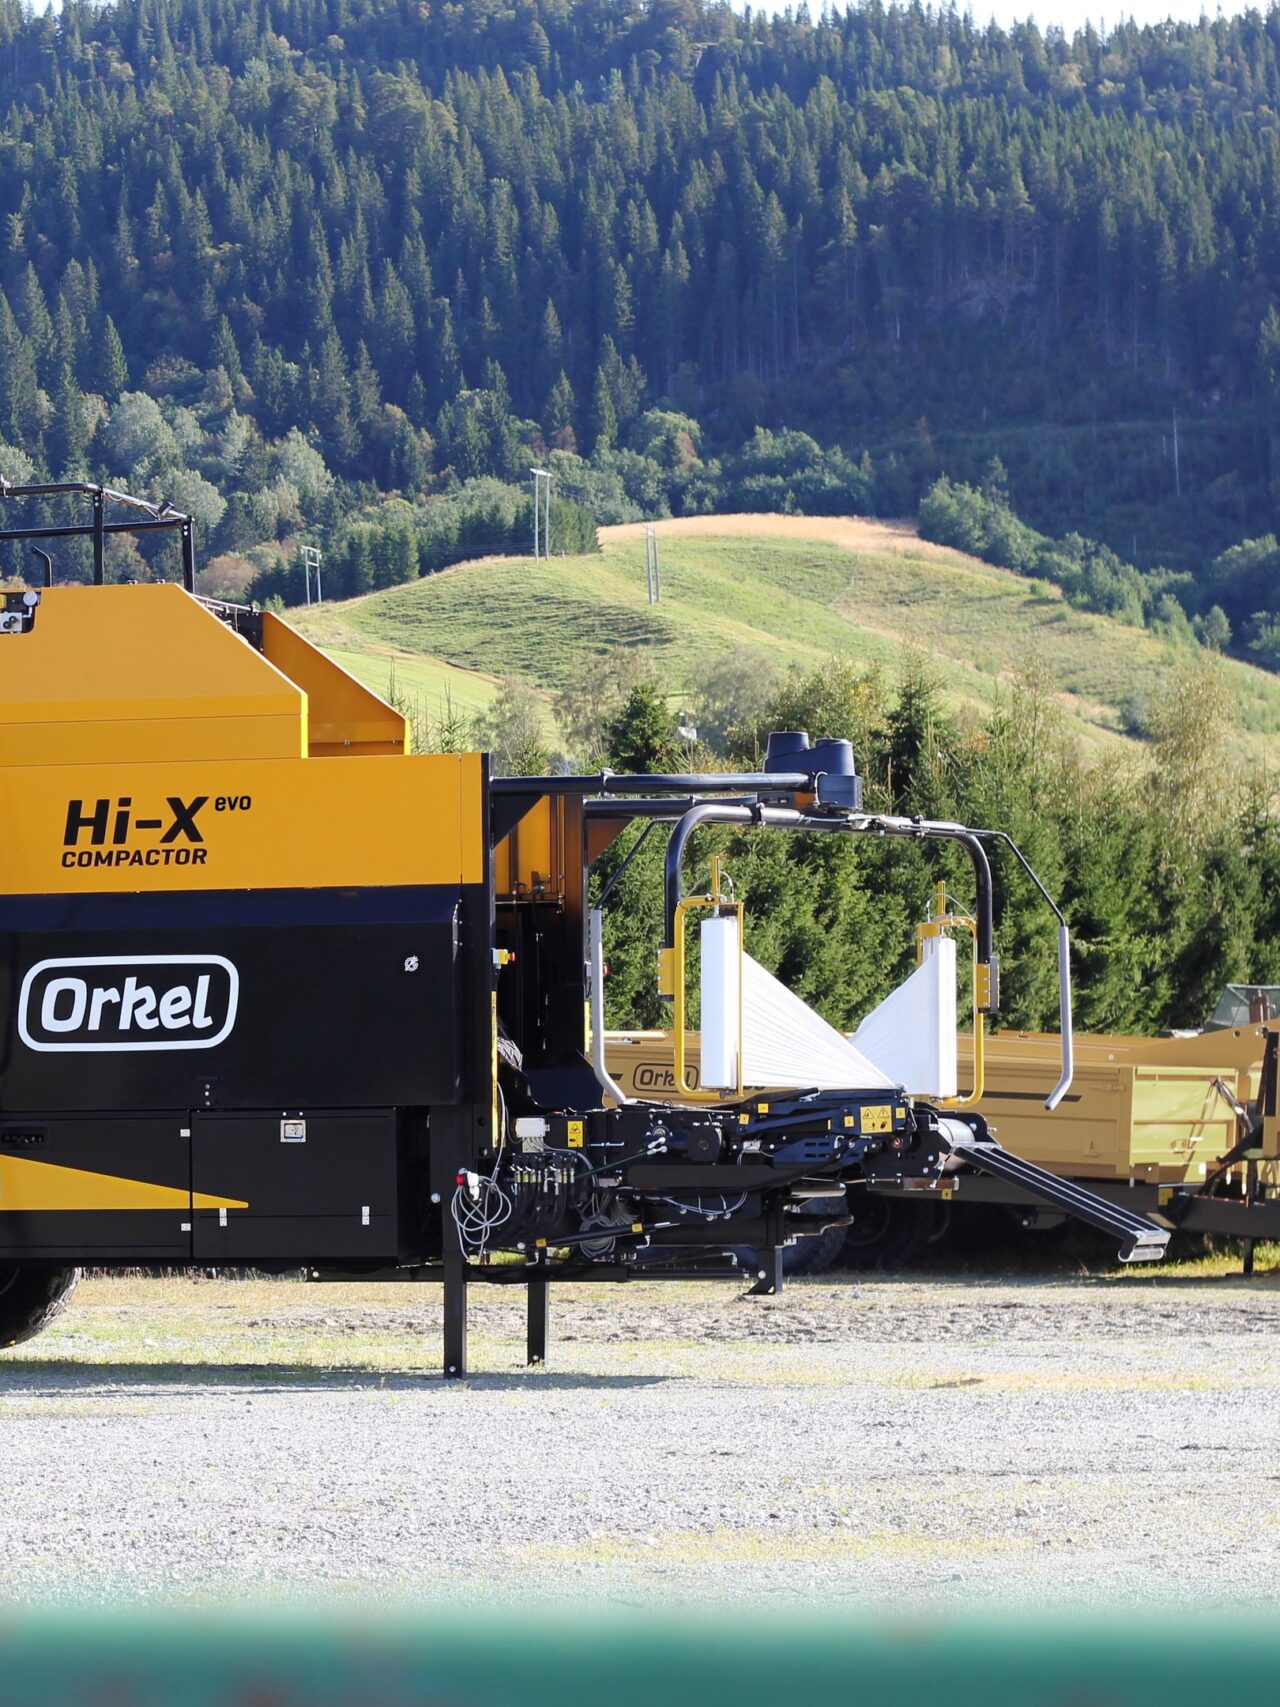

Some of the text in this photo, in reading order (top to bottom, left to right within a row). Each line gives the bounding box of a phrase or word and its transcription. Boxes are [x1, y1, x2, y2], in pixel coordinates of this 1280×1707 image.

[63, 795, 252, 846] Hi-X evo
[61, 848, 209, 868] COMPACTOR
[41, 974, 214, 1033] Orkel
[639, 1069, 691, 1087] Orkl
